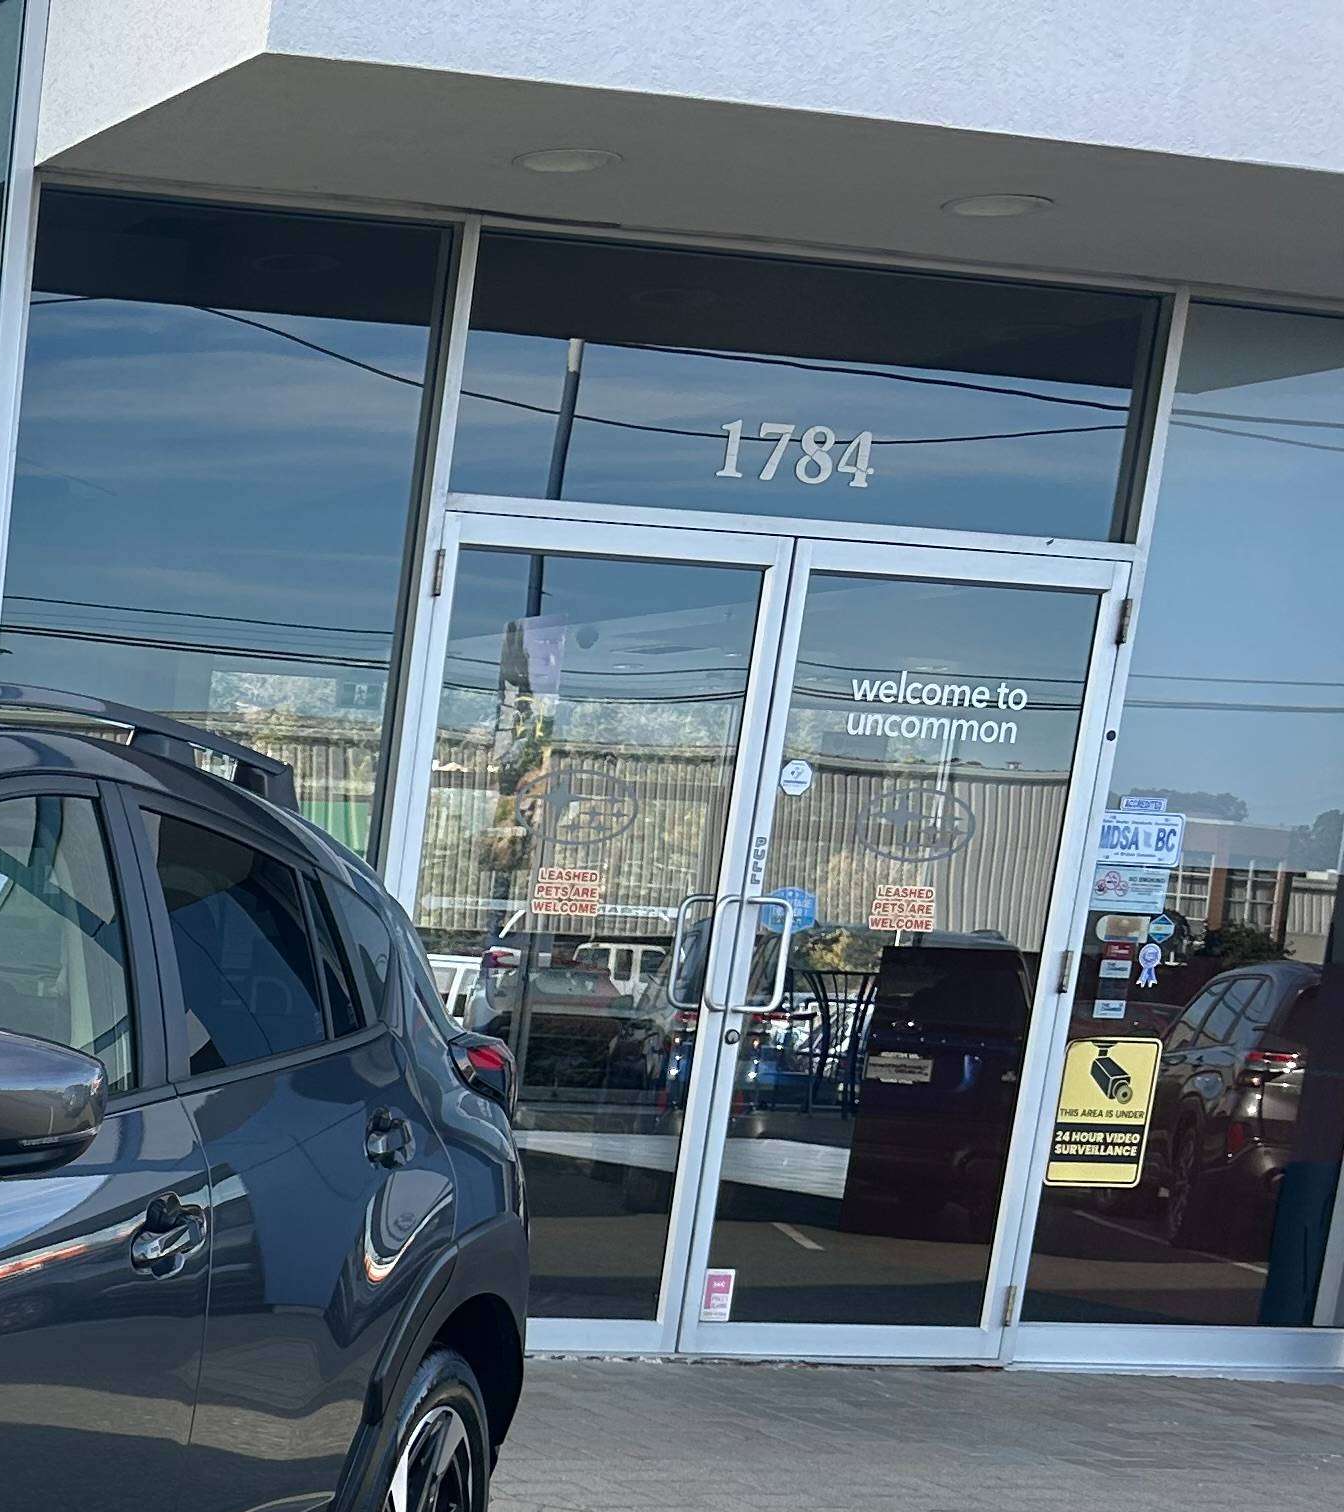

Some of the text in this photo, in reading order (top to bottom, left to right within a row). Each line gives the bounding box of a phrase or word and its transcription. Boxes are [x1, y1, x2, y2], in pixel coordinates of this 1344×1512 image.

[716, 420, 874, 488] 1784
[851, 670, 1028, 711] welcome to
[847, 712, 1018, 744] uncommon
[1098, 824, 1177, 853] MDSA BC
[750, 836, 767, 885] PULL
[540, 870, 598, 883] LEASHED
[536, 885, 598, 899] PETS ARE
[877, 886, 934, 899] LEASHED
[533, 902, 598, 914] WELCOME
[874, 902, 933, 915] PETS ARE
[870, 917, 932, 930] WELCOME
[1060, 1108, 1145, 1119] THIS AREA IS UNDER
[1055, 1130, 1140, 1144] 24 HOUR VIDEO
[1054, 1144, 1138, 1156] SURVEILLANCE
